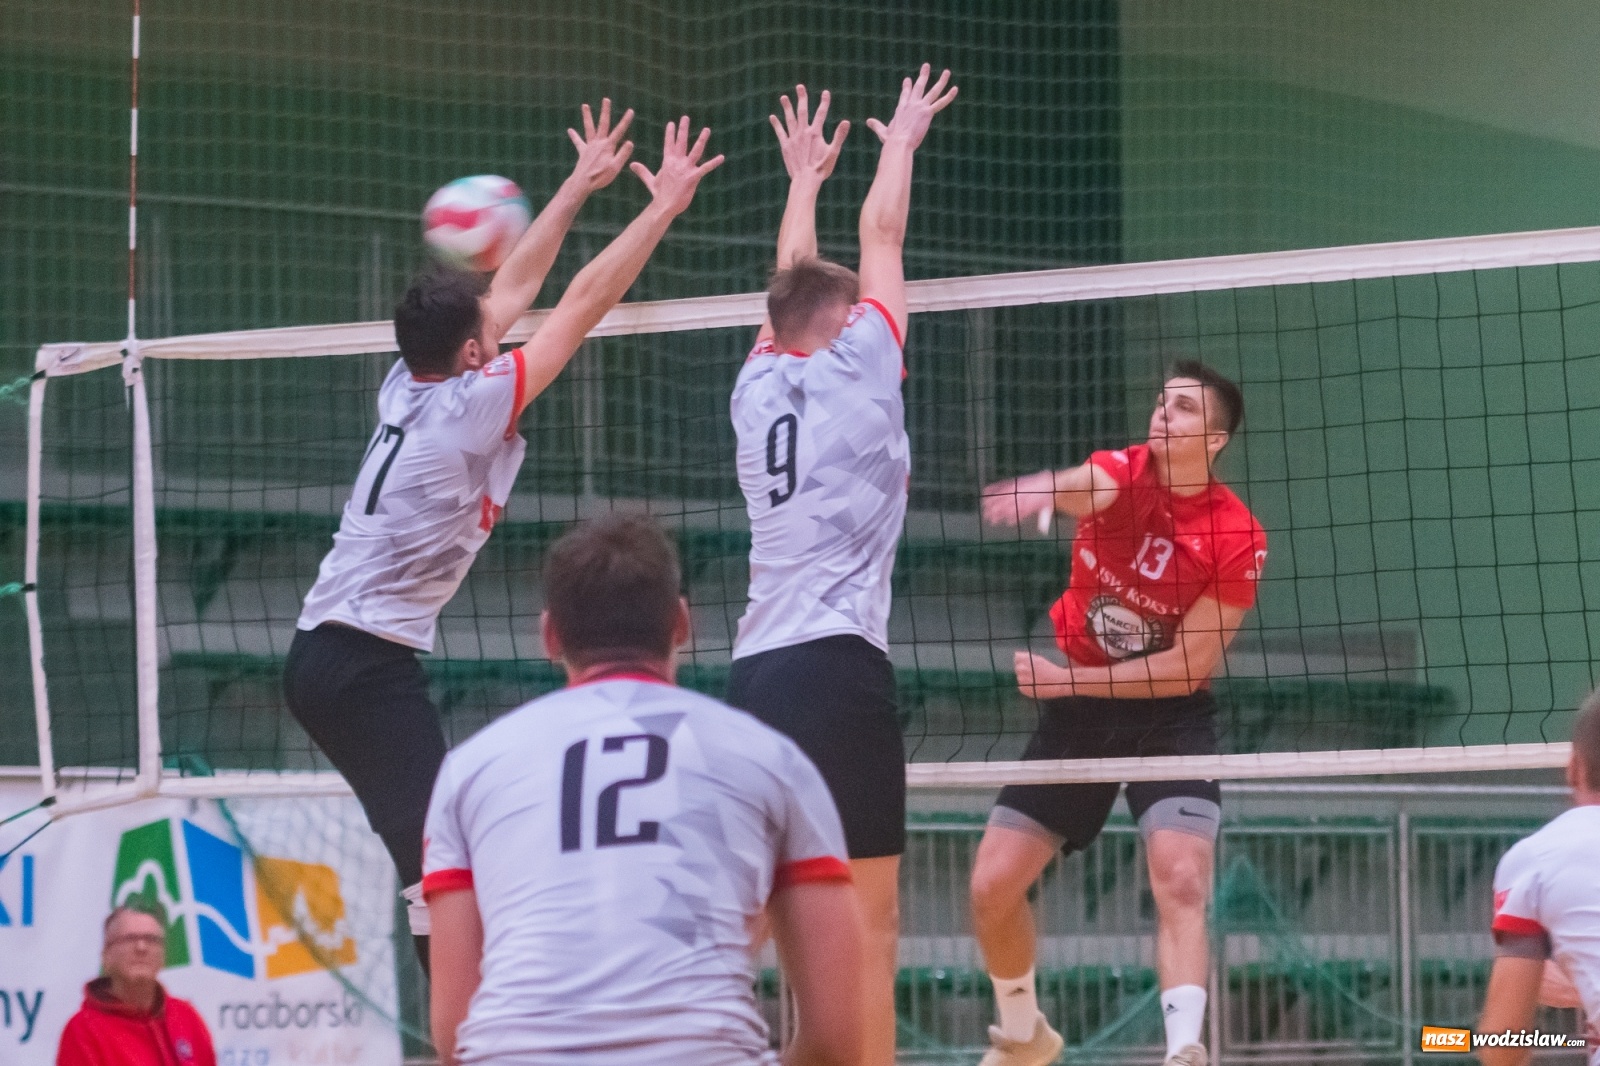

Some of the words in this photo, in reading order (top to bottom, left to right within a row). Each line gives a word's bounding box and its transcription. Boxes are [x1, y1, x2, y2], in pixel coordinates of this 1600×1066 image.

[766, 413, 797, 508] 9
[1130, 532, 1174, 580] 13
[1102, 612, 1140, 633] MARCEL
[561, 734, 669, 853] 12
